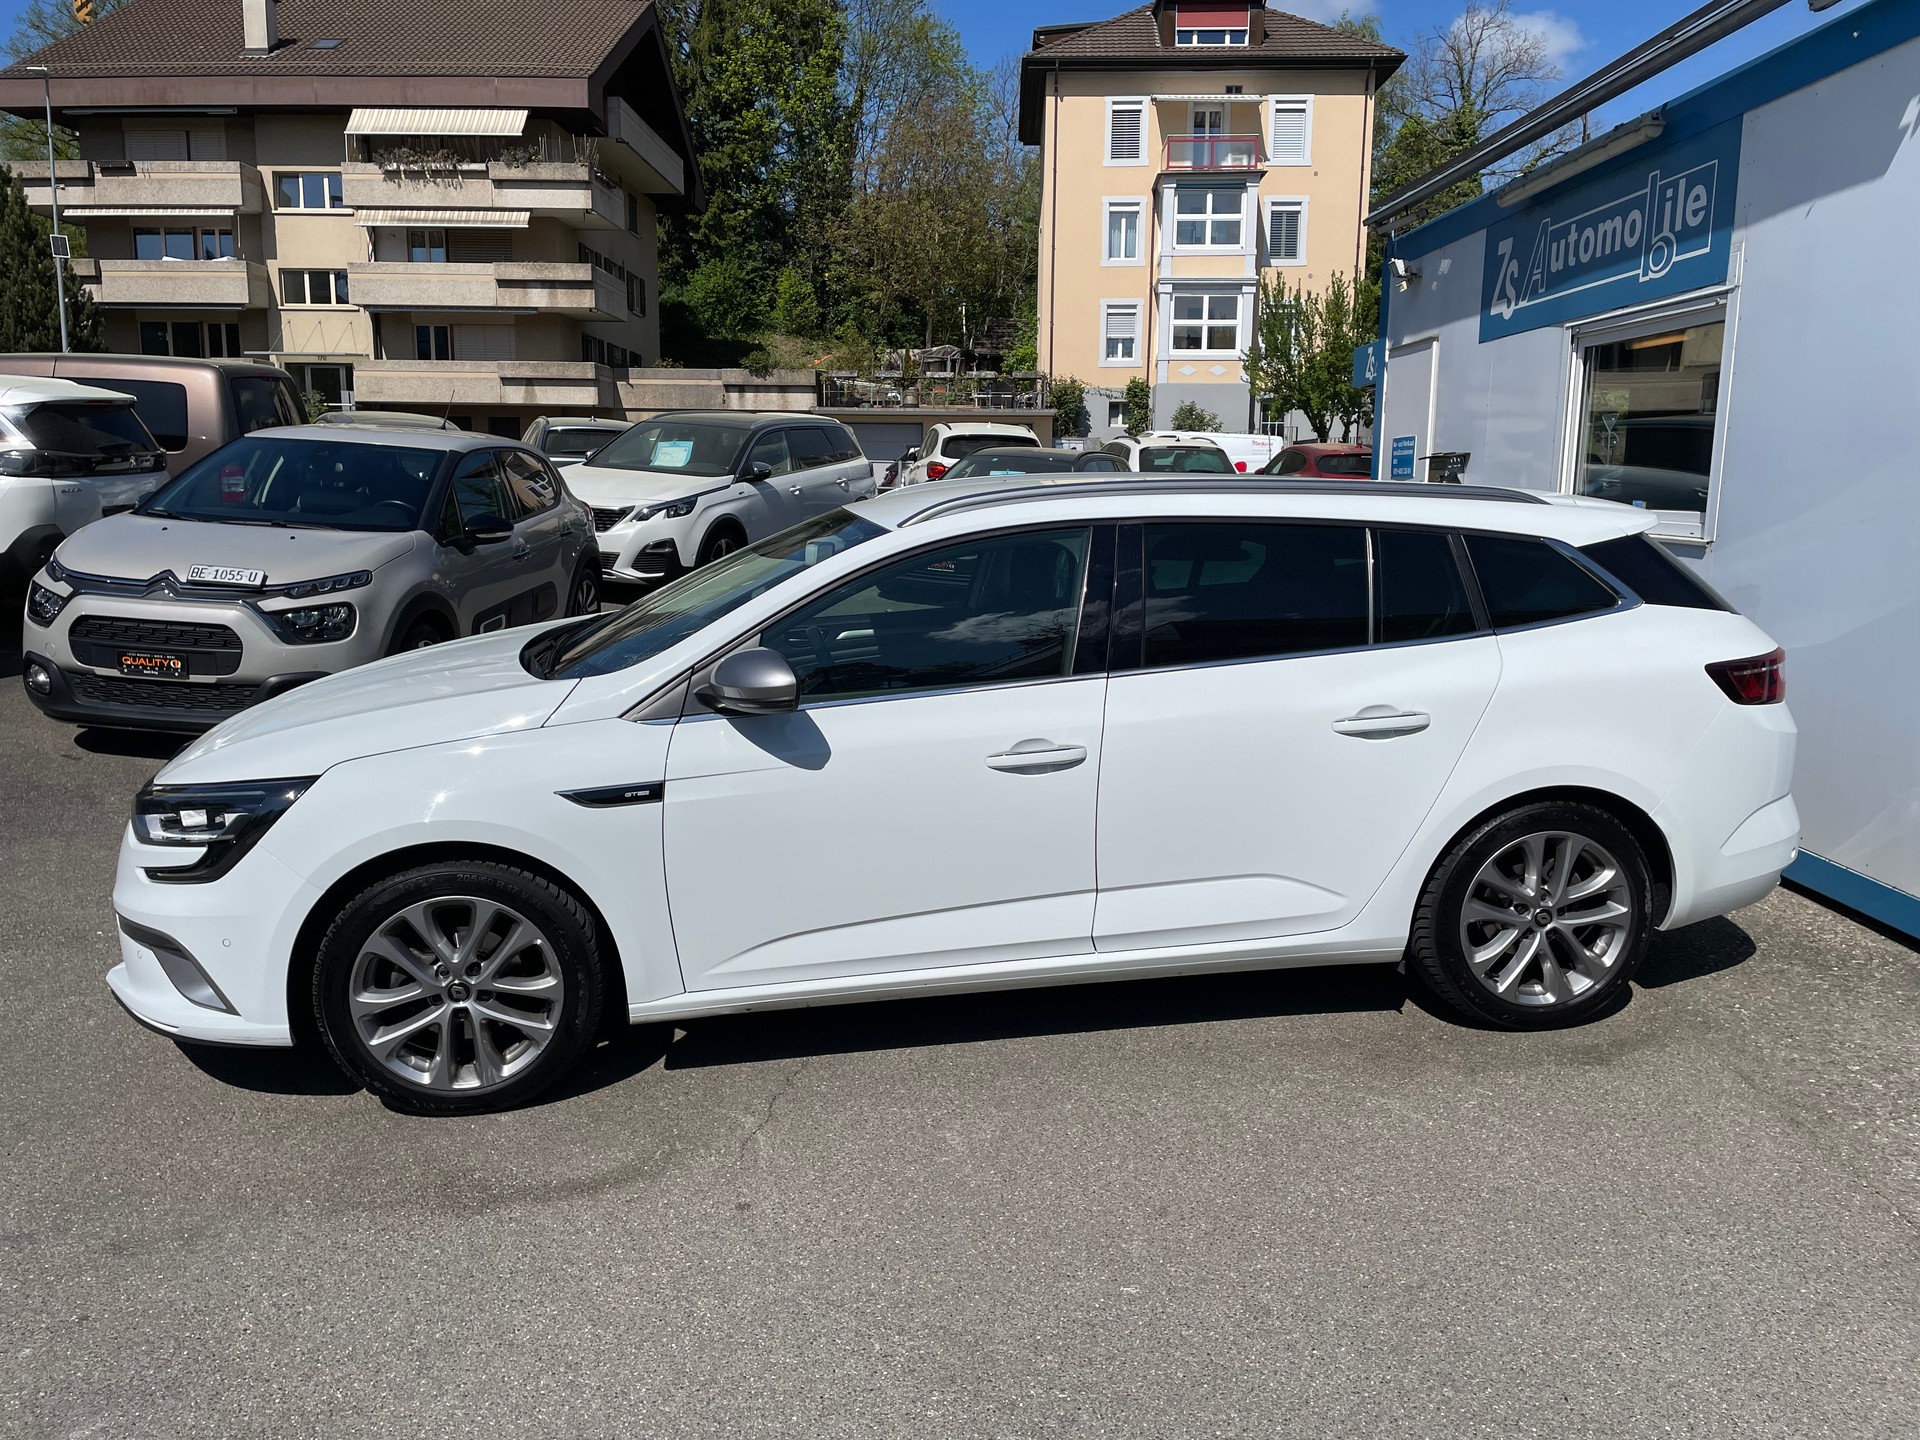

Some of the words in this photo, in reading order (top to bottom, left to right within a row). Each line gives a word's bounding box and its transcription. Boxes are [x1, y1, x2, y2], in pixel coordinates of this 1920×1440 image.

[1490, 236, 1520, 320] Zs
[1519, 169, 1708, 305] Automobile
[190, 567, 208, 579] BE
[212, 568, 245, 581] 1055
[248, 572, 258, 583] U
[456, 873, 494, 886] 205/50
